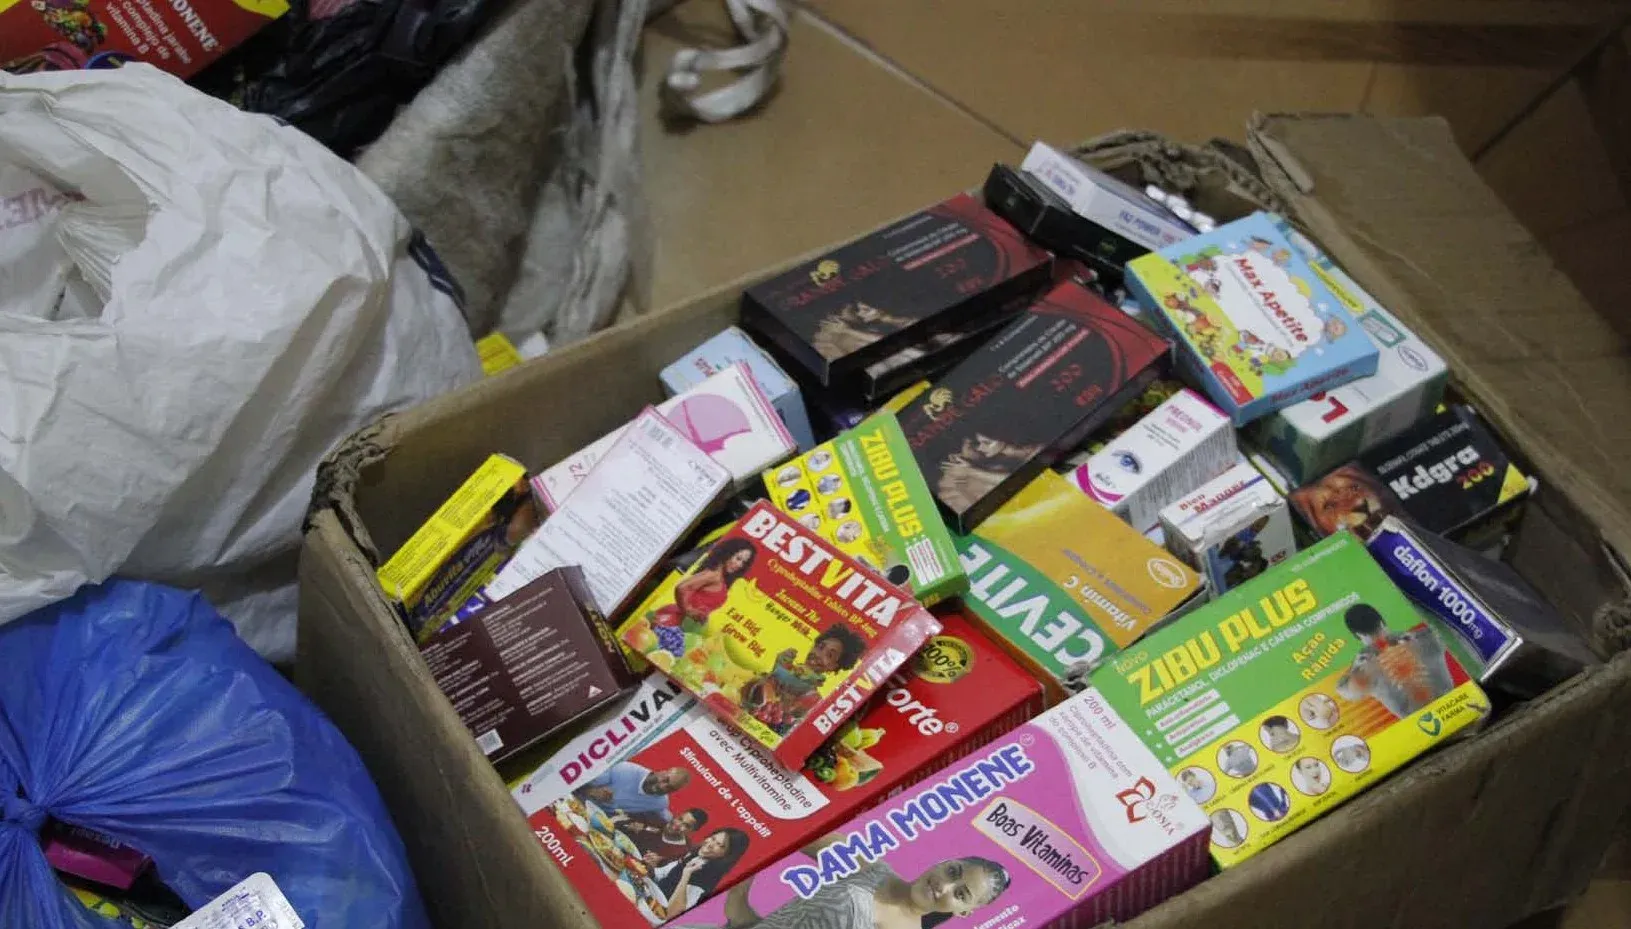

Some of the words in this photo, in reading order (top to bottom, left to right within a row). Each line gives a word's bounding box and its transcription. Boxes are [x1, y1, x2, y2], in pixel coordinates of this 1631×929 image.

[105, 2, 142, 47] vitamina
[137, 43, 149, 55] B
[166, 0, 220, 51] ONENE
[1234, 257, 1264, 289] Max
[1259, 288, 1309, 344] Apetite
[1179, 493, 1206, 512] Bien
[1389, 445, 1481, 501] Kdgra
[1458, 459, 1495, 490] 200
[879, 478, 925, 540] PLUS
[742, 509, 901, 628] BESTVITA
[1063, 575, 1079, 589] C
[1392, 543, 1441, 592] daflon
[1437, 580, 1484, 640] 1000mg
[720, 620, 750, 647] Grow
[725, 605, 745, 624] Eat
[960, 543, 1105, 667] CEVITE
[1079, 584, 1138, 631] Vitamin
[1127, 631, 1222, 706] ZIBU
[1219, 578, 1318, 652] PLUS
[811, 647, 907, 735] BESTVITA
[1082, 693, 1104, 717] 200
[678, 743, 723, 790] Stimulant
[716, 783, 735, 802] de
[708, 727, 734, 754] avec
[730, 749, 793, 814] Multivitamine
[782, 820, 898, 899] DAMA
[891, 744, 1035, 841] MONENE
[985, 801, 1026, 842] Boas
[1018, 822, 1090, 892] Vitaminas
